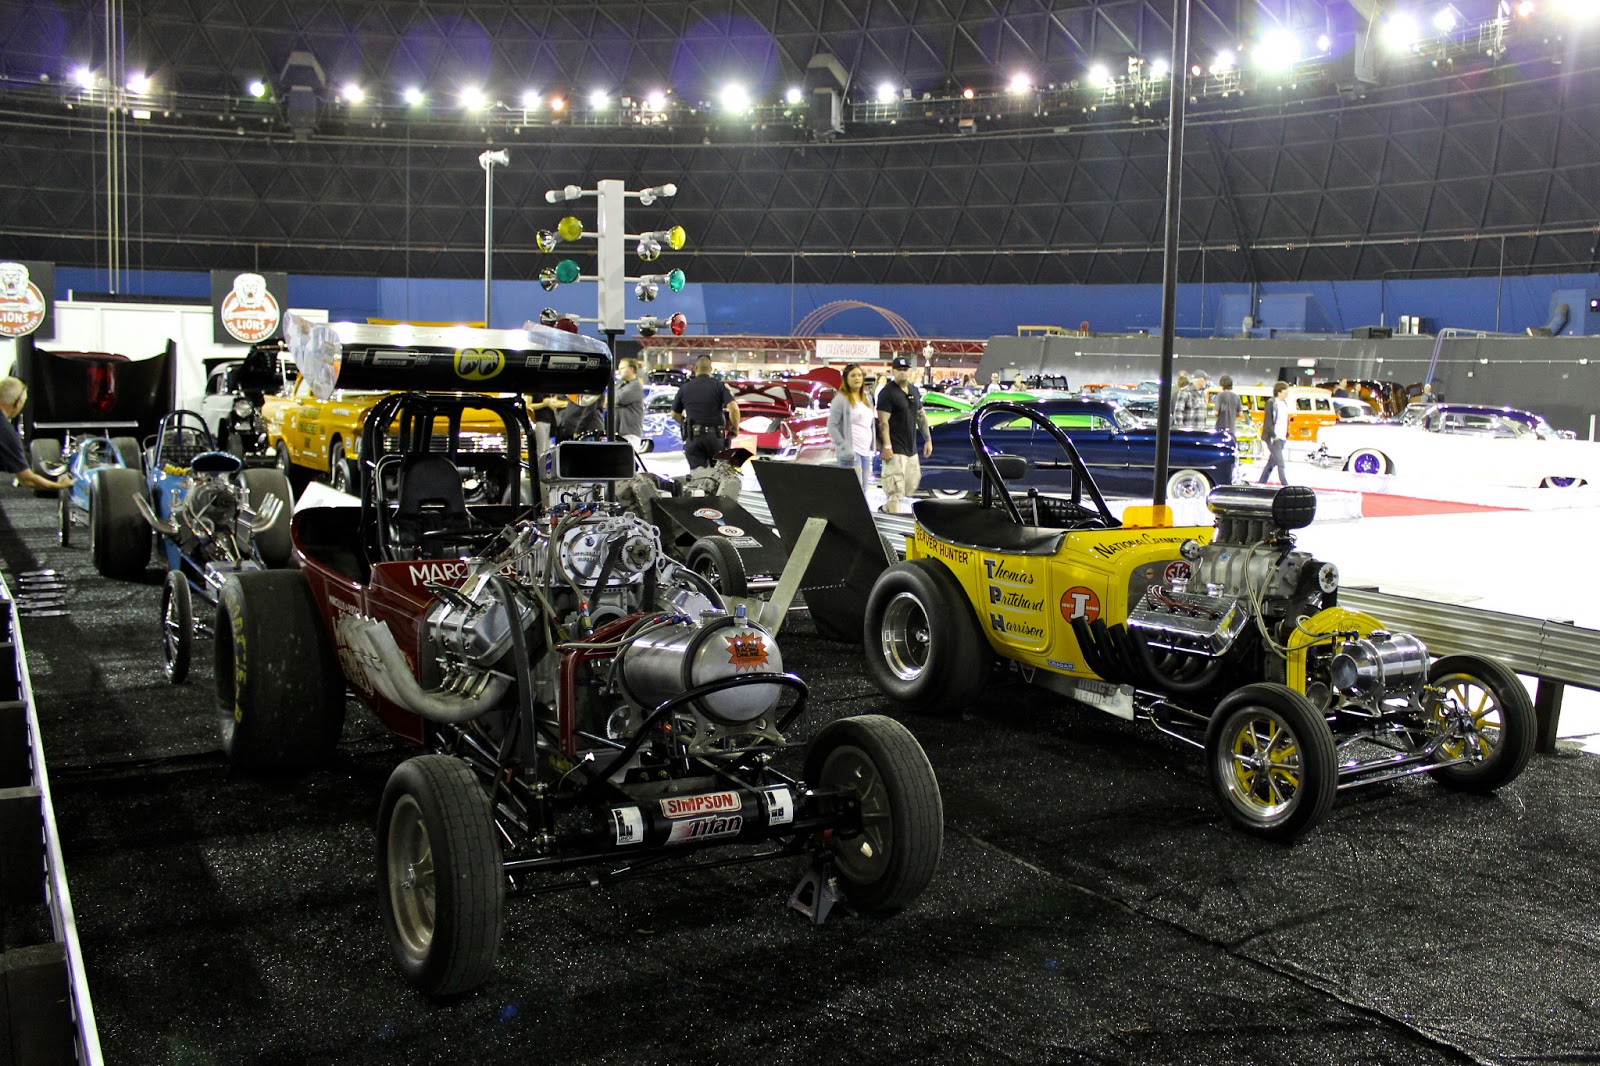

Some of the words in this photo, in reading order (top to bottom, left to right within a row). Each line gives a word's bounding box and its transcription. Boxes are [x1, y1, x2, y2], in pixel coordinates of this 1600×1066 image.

[14, 316, 38, 333] STRIP
[236, 319, 265, 330] LIONS
[939, 543, 969, 565] HUNTER
[984, 558, 1034, 585] Thomas
[989, 584, 1045, 612] Pritchard
[989, 611, 1045, 638] Harrison
[668, 793, 733, 814] SIMPSON
[689, 815, 742, 838] Titan
